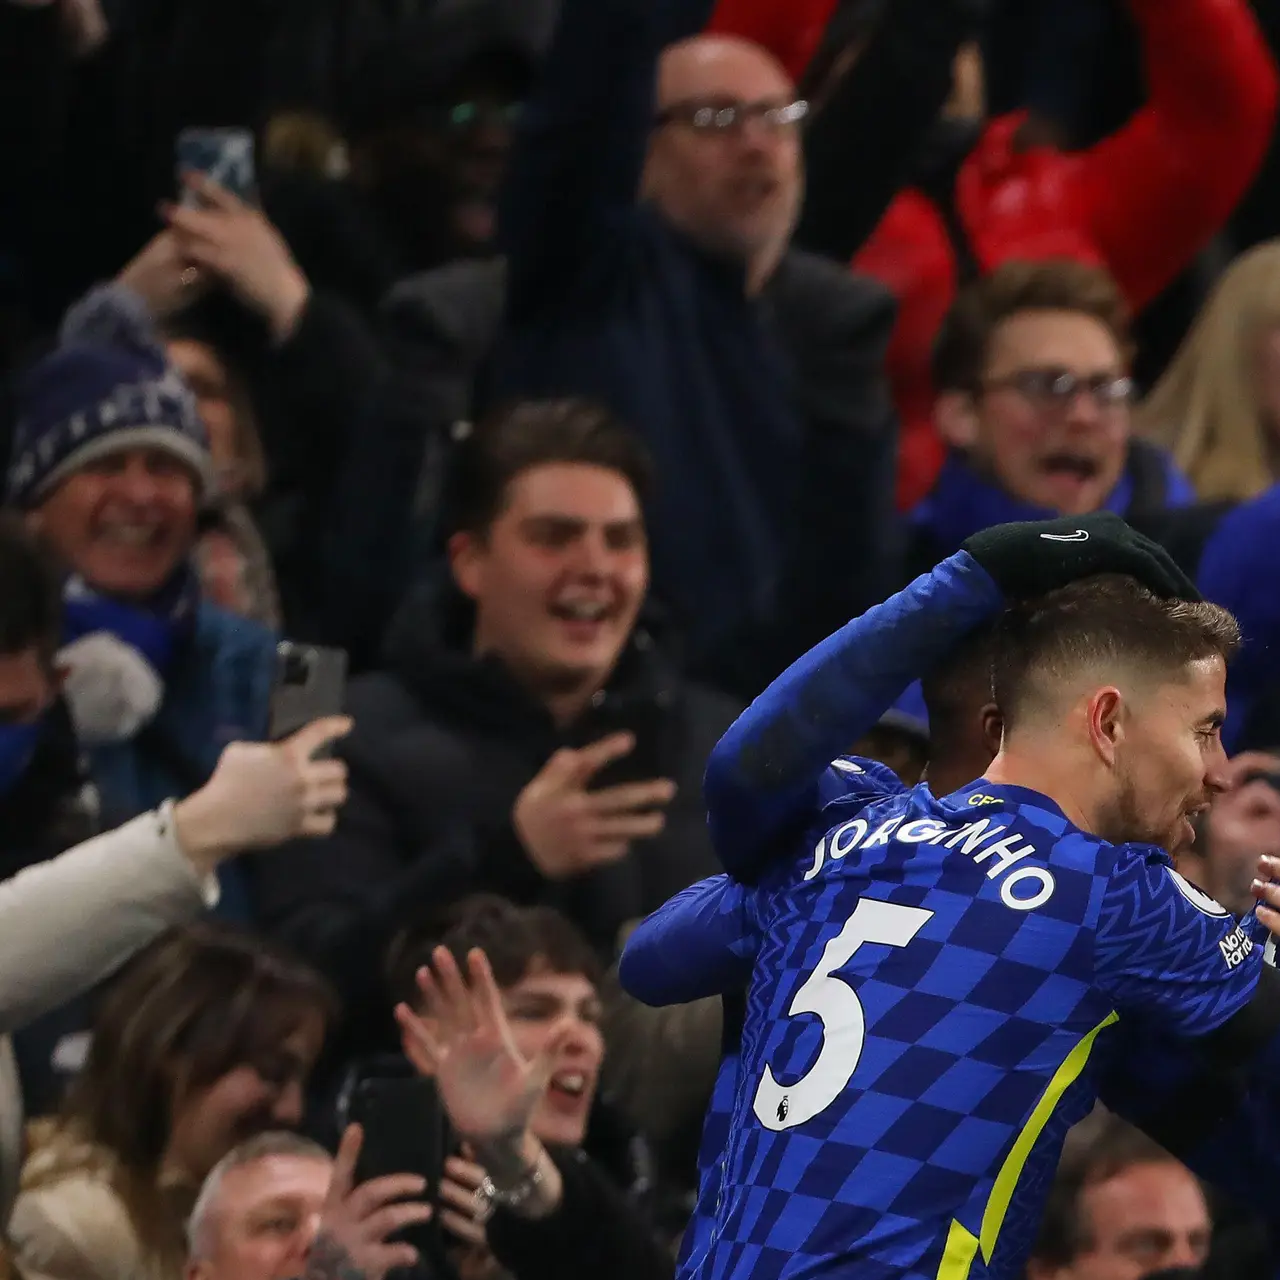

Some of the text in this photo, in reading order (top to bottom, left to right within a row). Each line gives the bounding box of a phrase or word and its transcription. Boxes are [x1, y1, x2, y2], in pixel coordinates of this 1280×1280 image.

[803, 814, 1055, 911] JORGINHO
[1218, 933, 1238, 956] No
[1225, 949, 1245, 970] For
[753, 896, 934, 1131] 5
